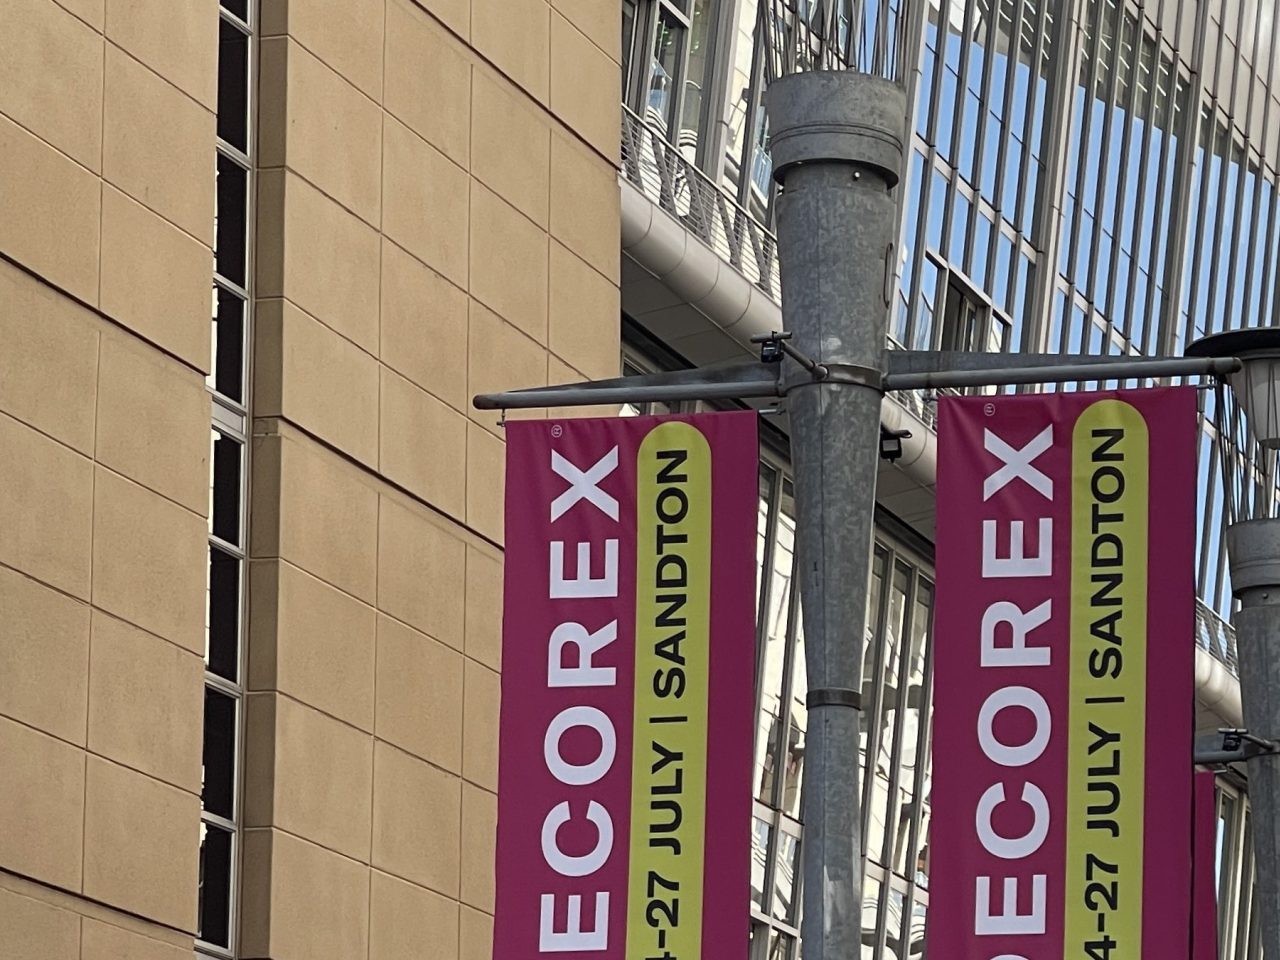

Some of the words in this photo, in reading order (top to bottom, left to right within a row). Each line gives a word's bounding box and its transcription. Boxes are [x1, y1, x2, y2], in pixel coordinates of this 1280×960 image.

[653, 450, 688, 698] SANDTON
[1089, 429, 1125, 679] SANDTON
[650, 741, 683, 855] JULY
[1087, 722, 1120, 837] JULY
